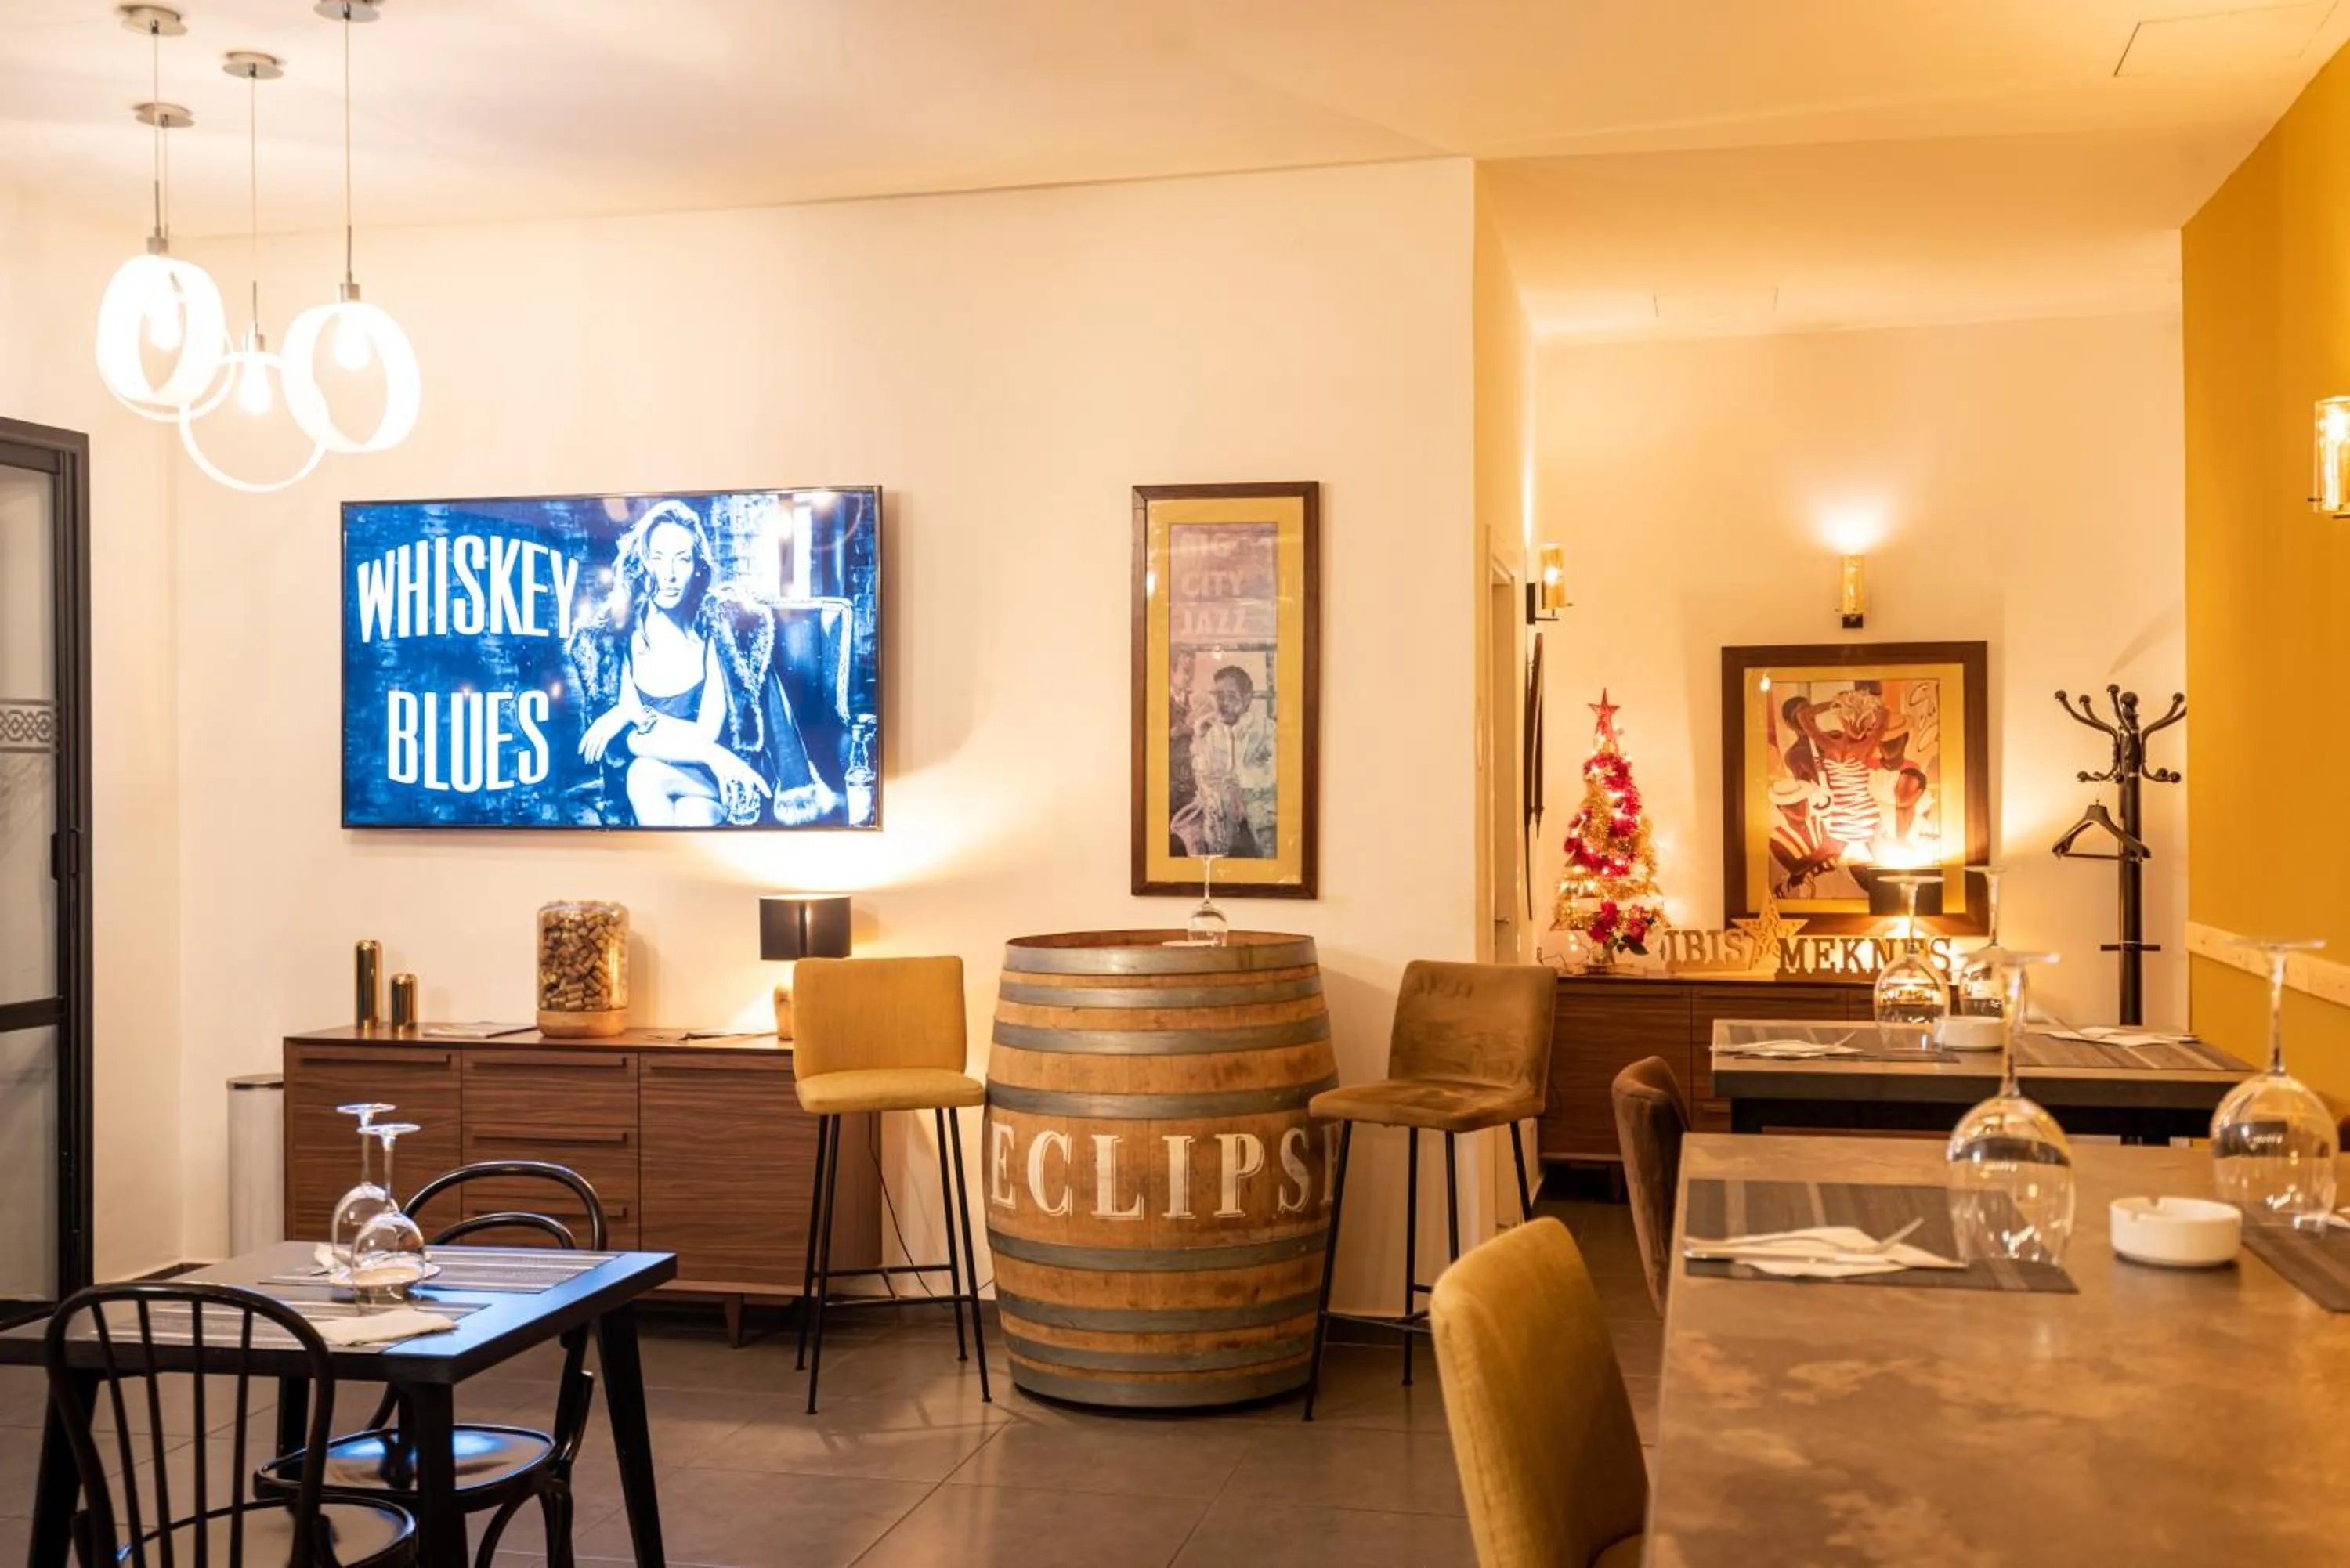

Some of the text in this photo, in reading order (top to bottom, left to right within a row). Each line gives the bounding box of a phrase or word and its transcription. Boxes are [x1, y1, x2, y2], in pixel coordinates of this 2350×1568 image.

[357, 534, 578, 642] WHISKEY
[1181, 570, 1243, 597] CITY
[1180, 607, 1249, 635] JAZZ
[389, 689, 549, 793] BLUES
[1663, 930, 1747, 969] IBIS
